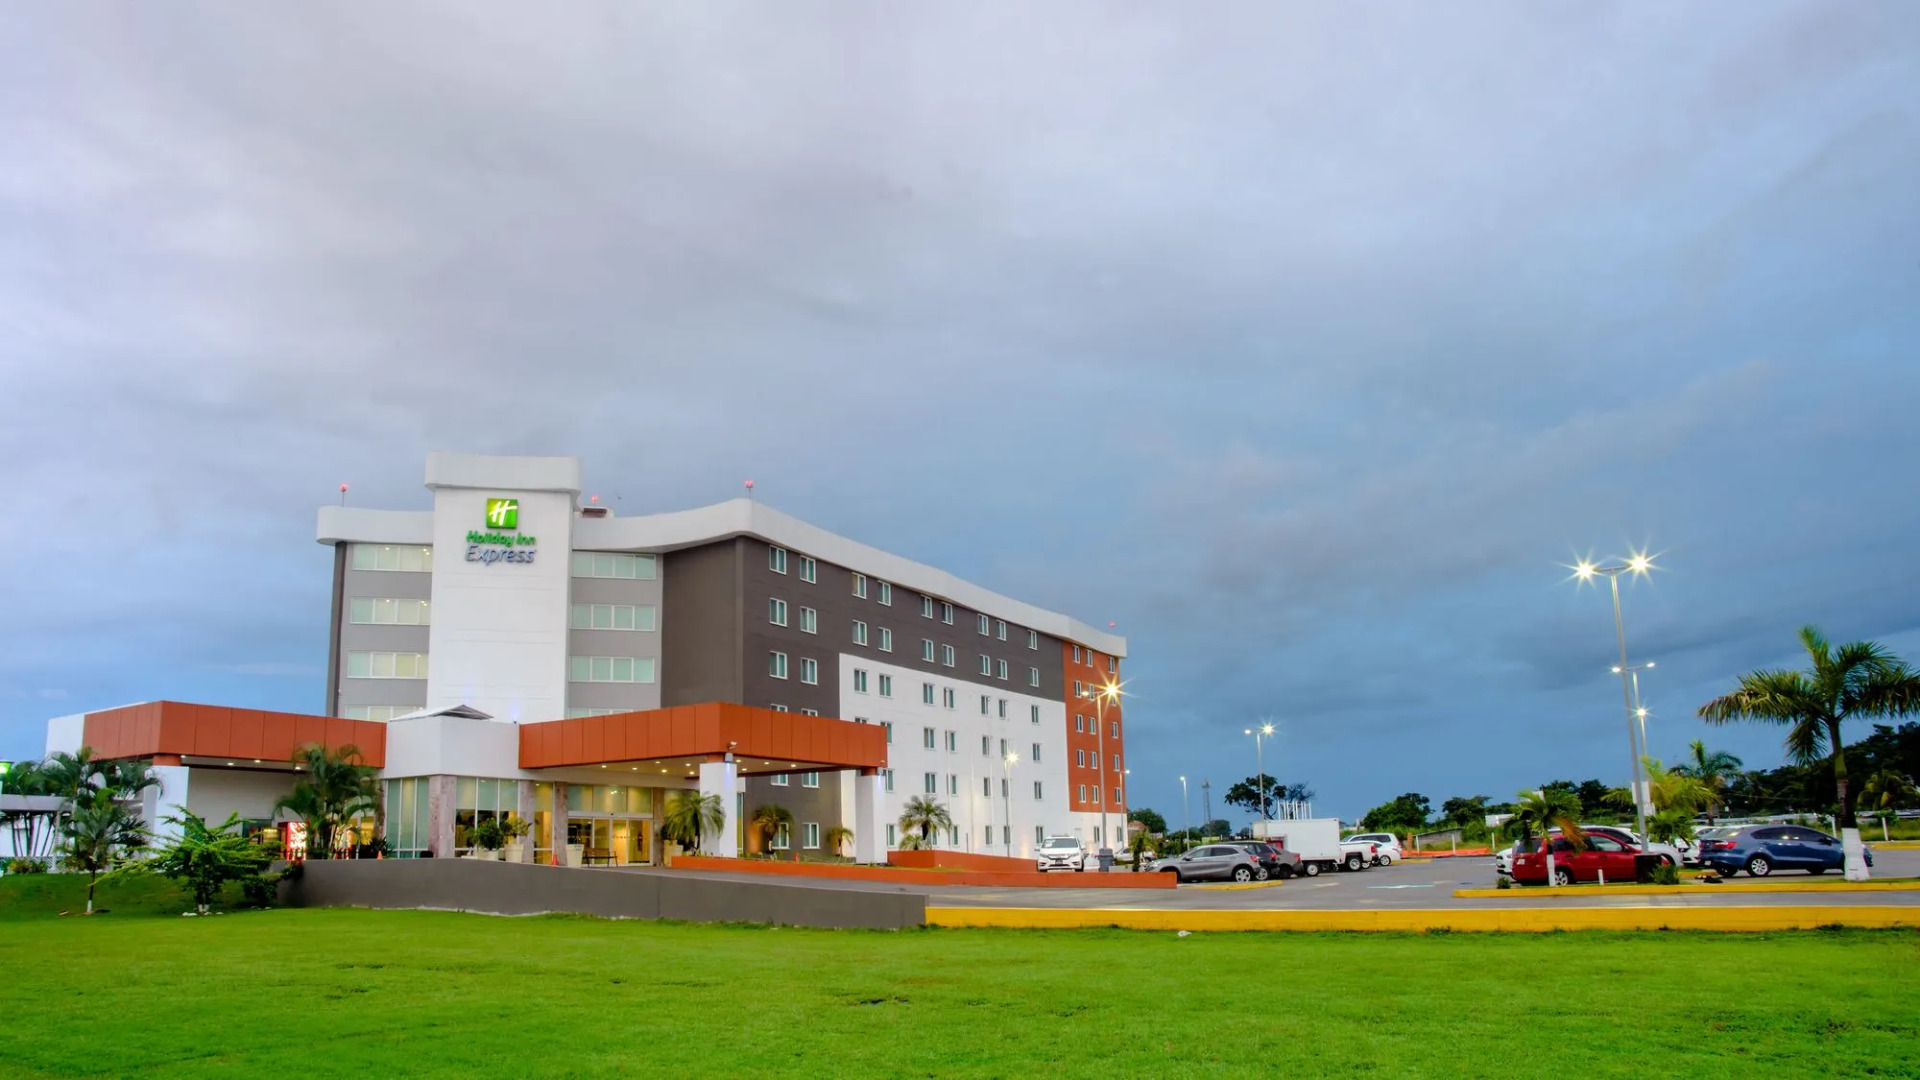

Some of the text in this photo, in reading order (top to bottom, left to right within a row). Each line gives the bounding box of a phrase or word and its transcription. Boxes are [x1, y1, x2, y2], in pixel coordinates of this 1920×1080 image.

[488, 500, 518, 526] H
[466, 530, 536, 547] Holiday Inn
[465, 545, 537, 566] Express
